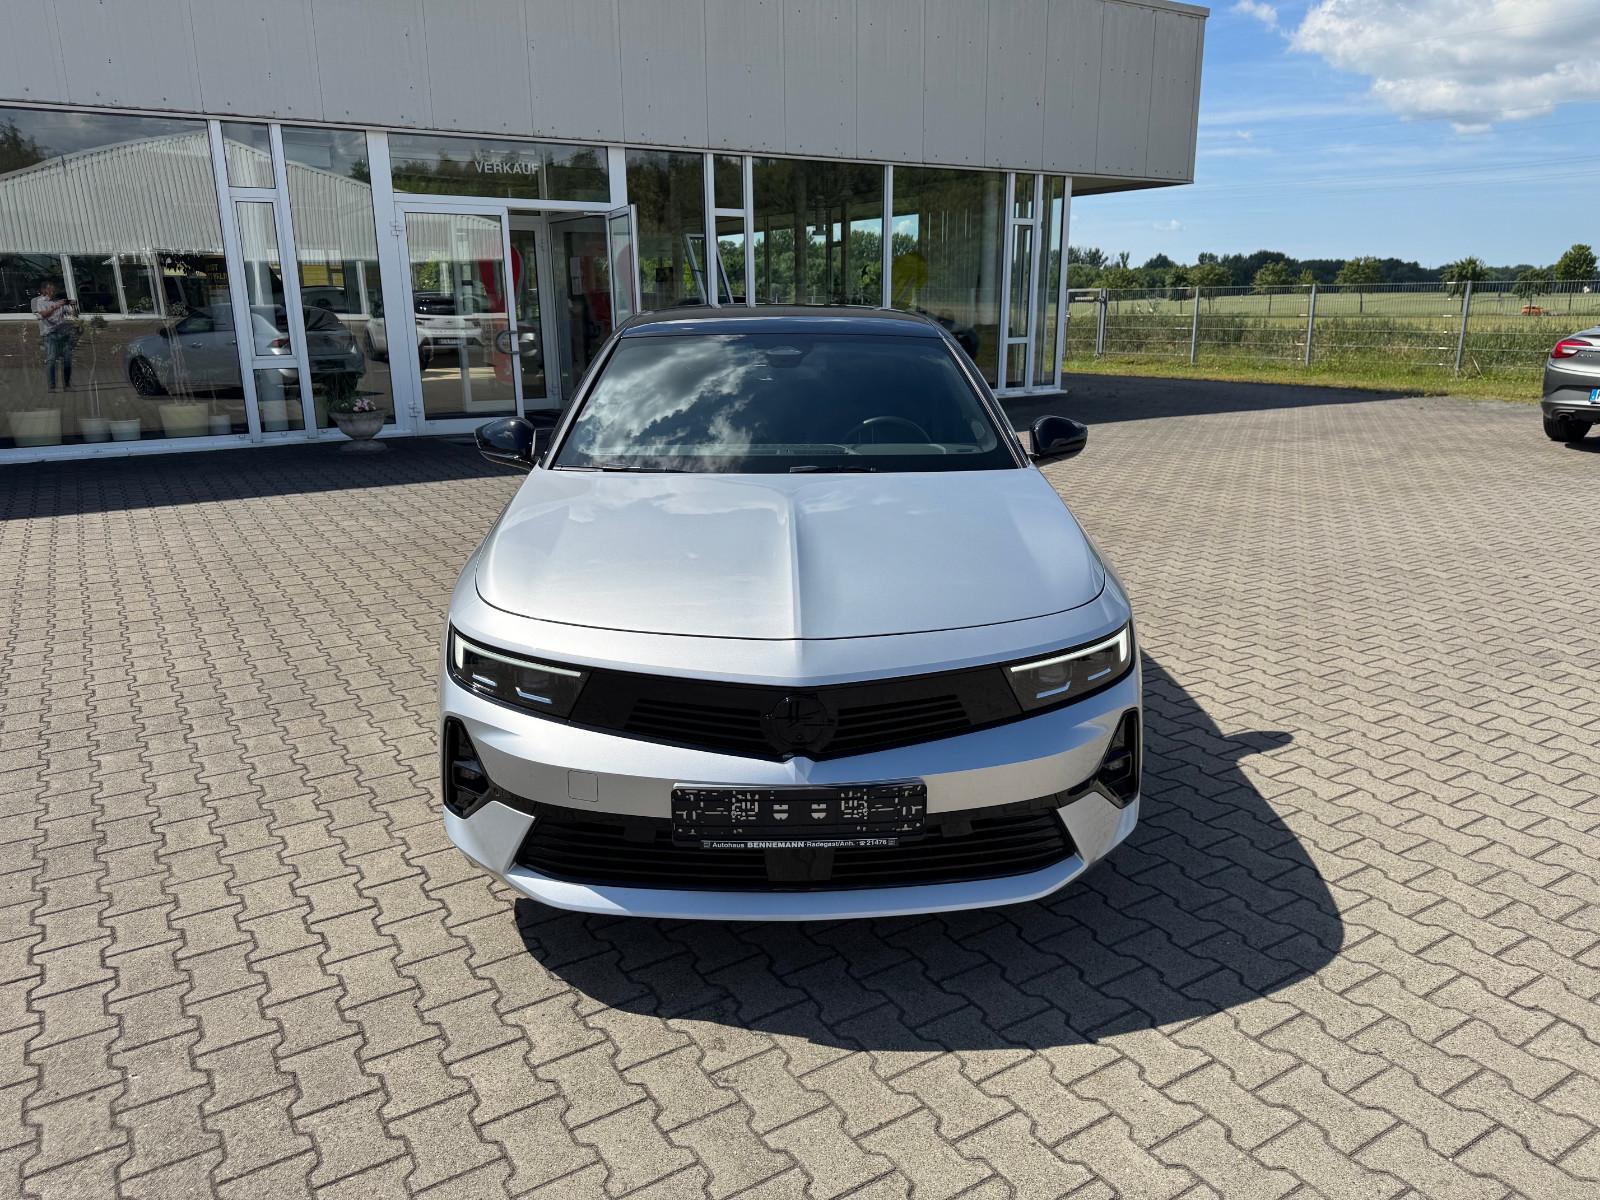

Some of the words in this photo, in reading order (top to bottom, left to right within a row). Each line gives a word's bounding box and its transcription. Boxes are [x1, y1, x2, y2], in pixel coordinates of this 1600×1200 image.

[474, 160, 539, 175] VERKAUF
[712, 841, 745, 849] Autohaus
[747, 840, 805, 849] BENNEMANN
